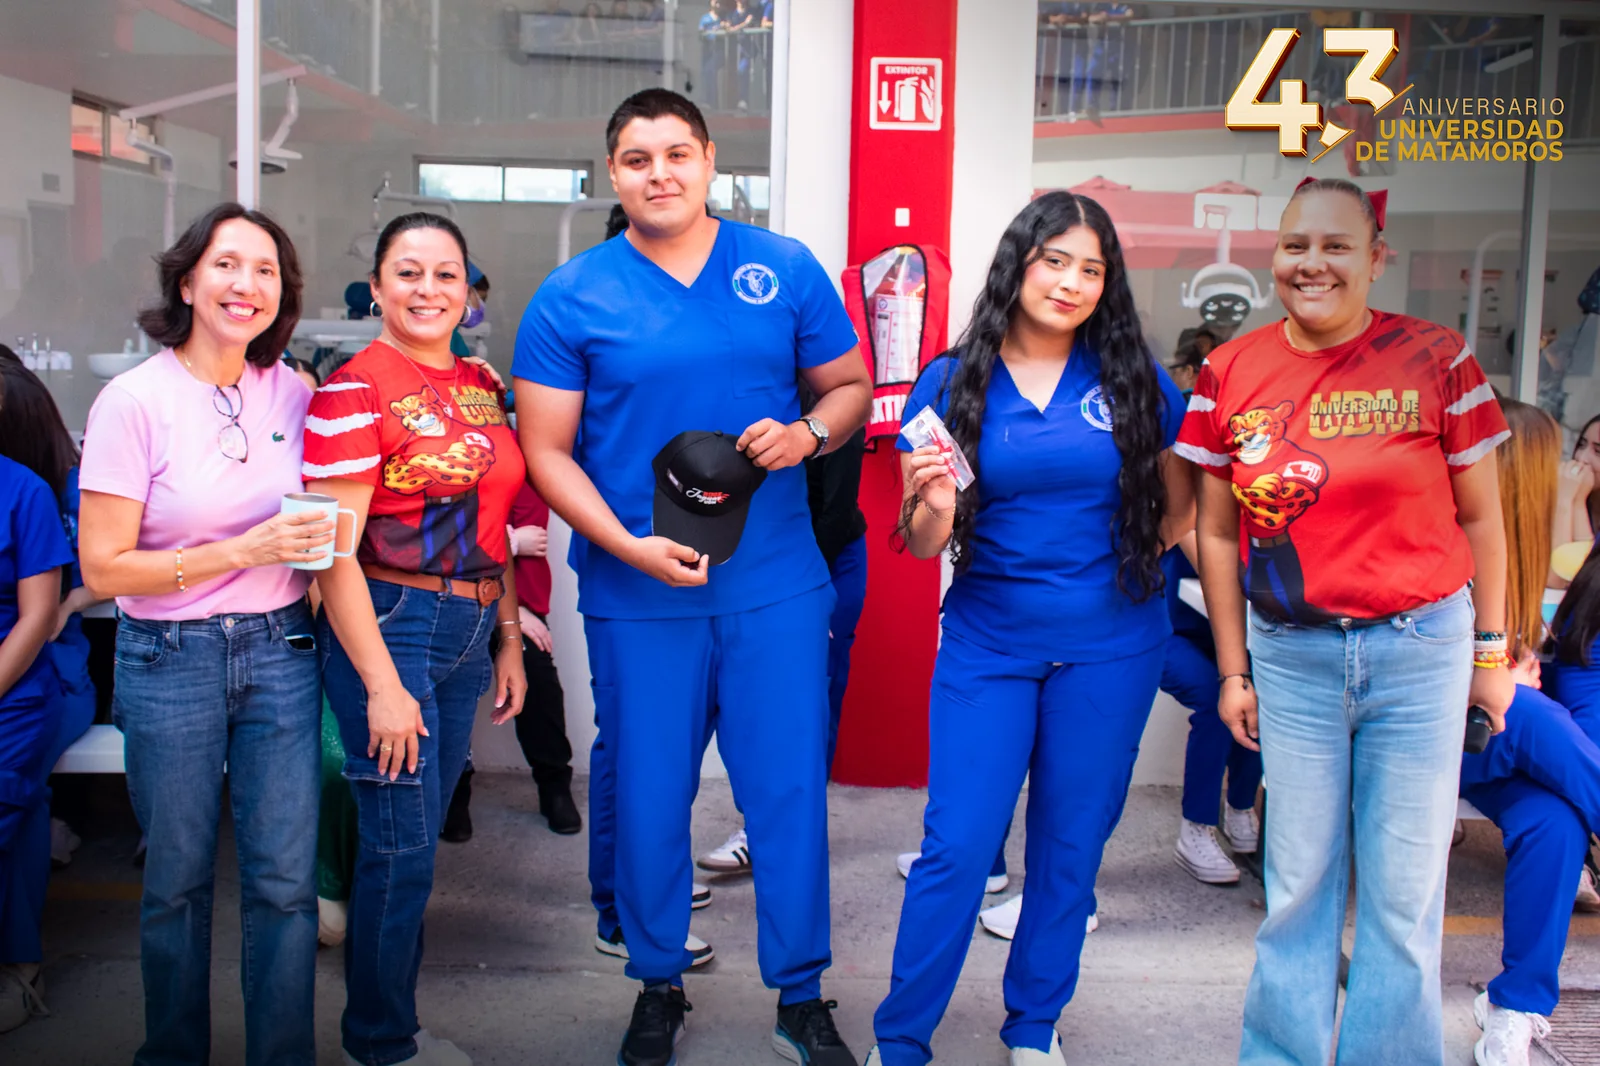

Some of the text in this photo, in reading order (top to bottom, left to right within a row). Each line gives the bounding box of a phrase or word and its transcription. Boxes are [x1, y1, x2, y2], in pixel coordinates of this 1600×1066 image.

[885, 65, 928, 75] EXTINTOR
[1309, 399, 1419, 414] UNIVERSIDAD DE
[1309, 412, 1420, 428] MATAMOROS
